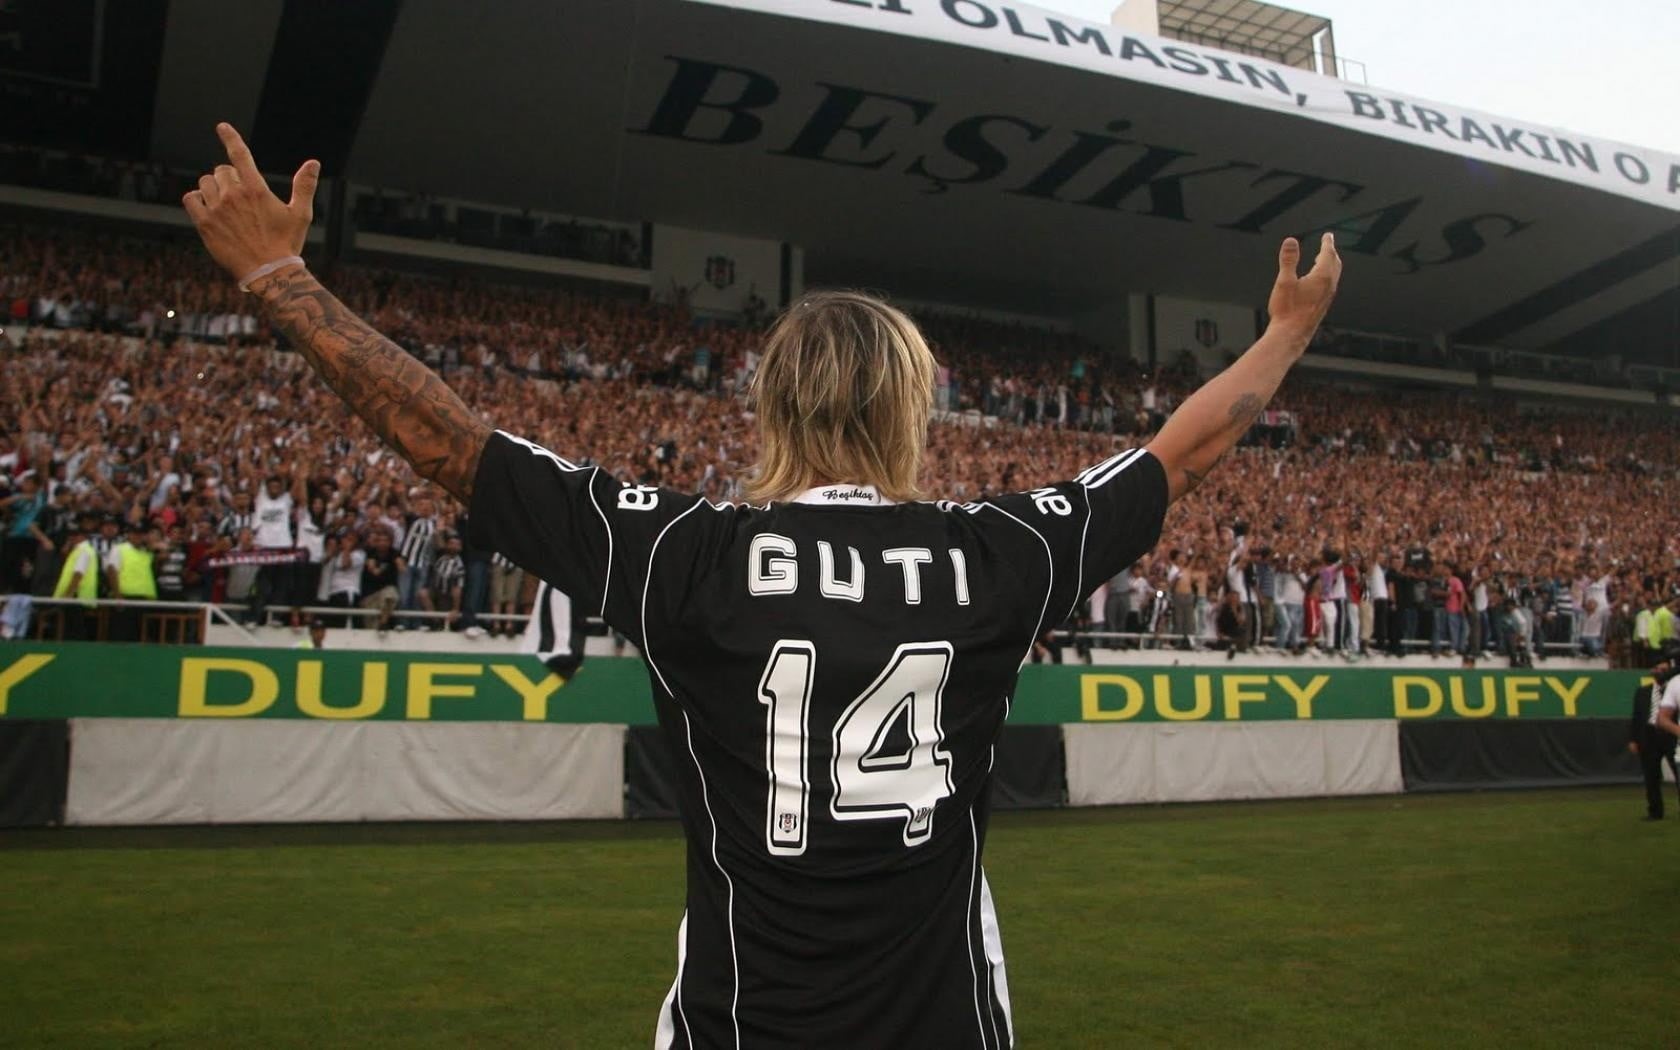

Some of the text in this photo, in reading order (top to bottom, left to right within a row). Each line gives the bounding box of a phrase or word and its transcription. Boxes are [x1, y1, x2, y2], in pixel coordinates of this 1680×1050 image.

[627, 55, 1533, 276] BEŞİKTAŞ
[1344, 90, 1600, 173] BIRAKIN
[1614, 151, 1650, 185] O
[748, 533, 970, 606] GUTI
[178, 657, 580, 721] DUFY
[1080, 674, 1591, 721] DUFY DUFY
[758, 639, 956, 857] 14
